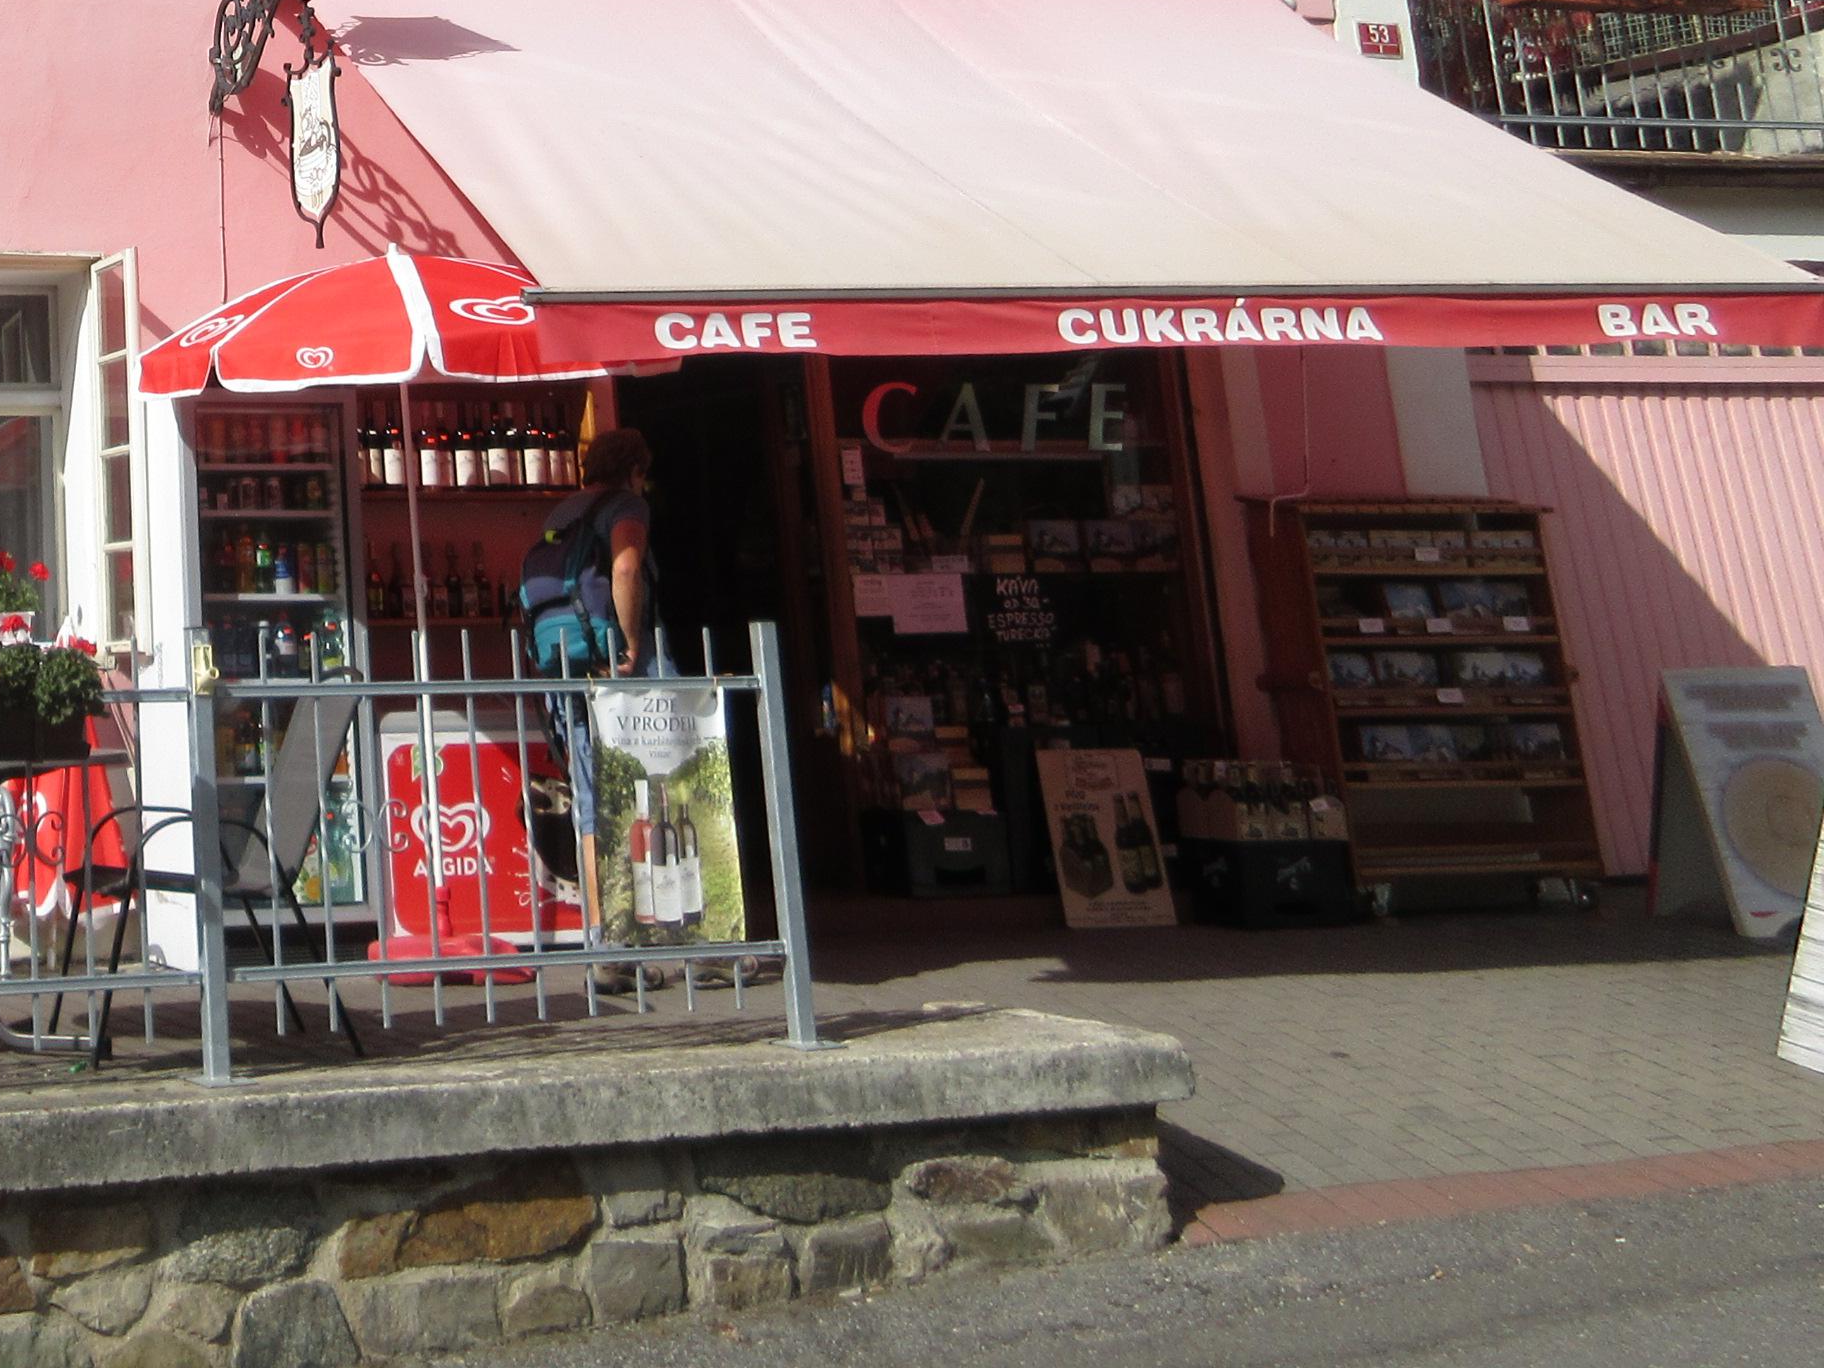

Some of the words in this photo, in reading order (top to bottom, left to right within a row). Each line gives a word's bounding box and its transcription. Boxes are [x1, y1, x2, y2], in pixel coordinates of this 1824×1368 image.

[1368, 24, 1390, 43] 53
[654, 312, 817, 350] CAFE
[1057, 298, 1383, 344] CUKRÁRNA
[1598, 303, 1718, 337] BAR
[862, 381, 1127, 453] CAFE
[987, 612, 1055, 630] ESPRESSO
[413, 857, 494, 877] AGIDA
